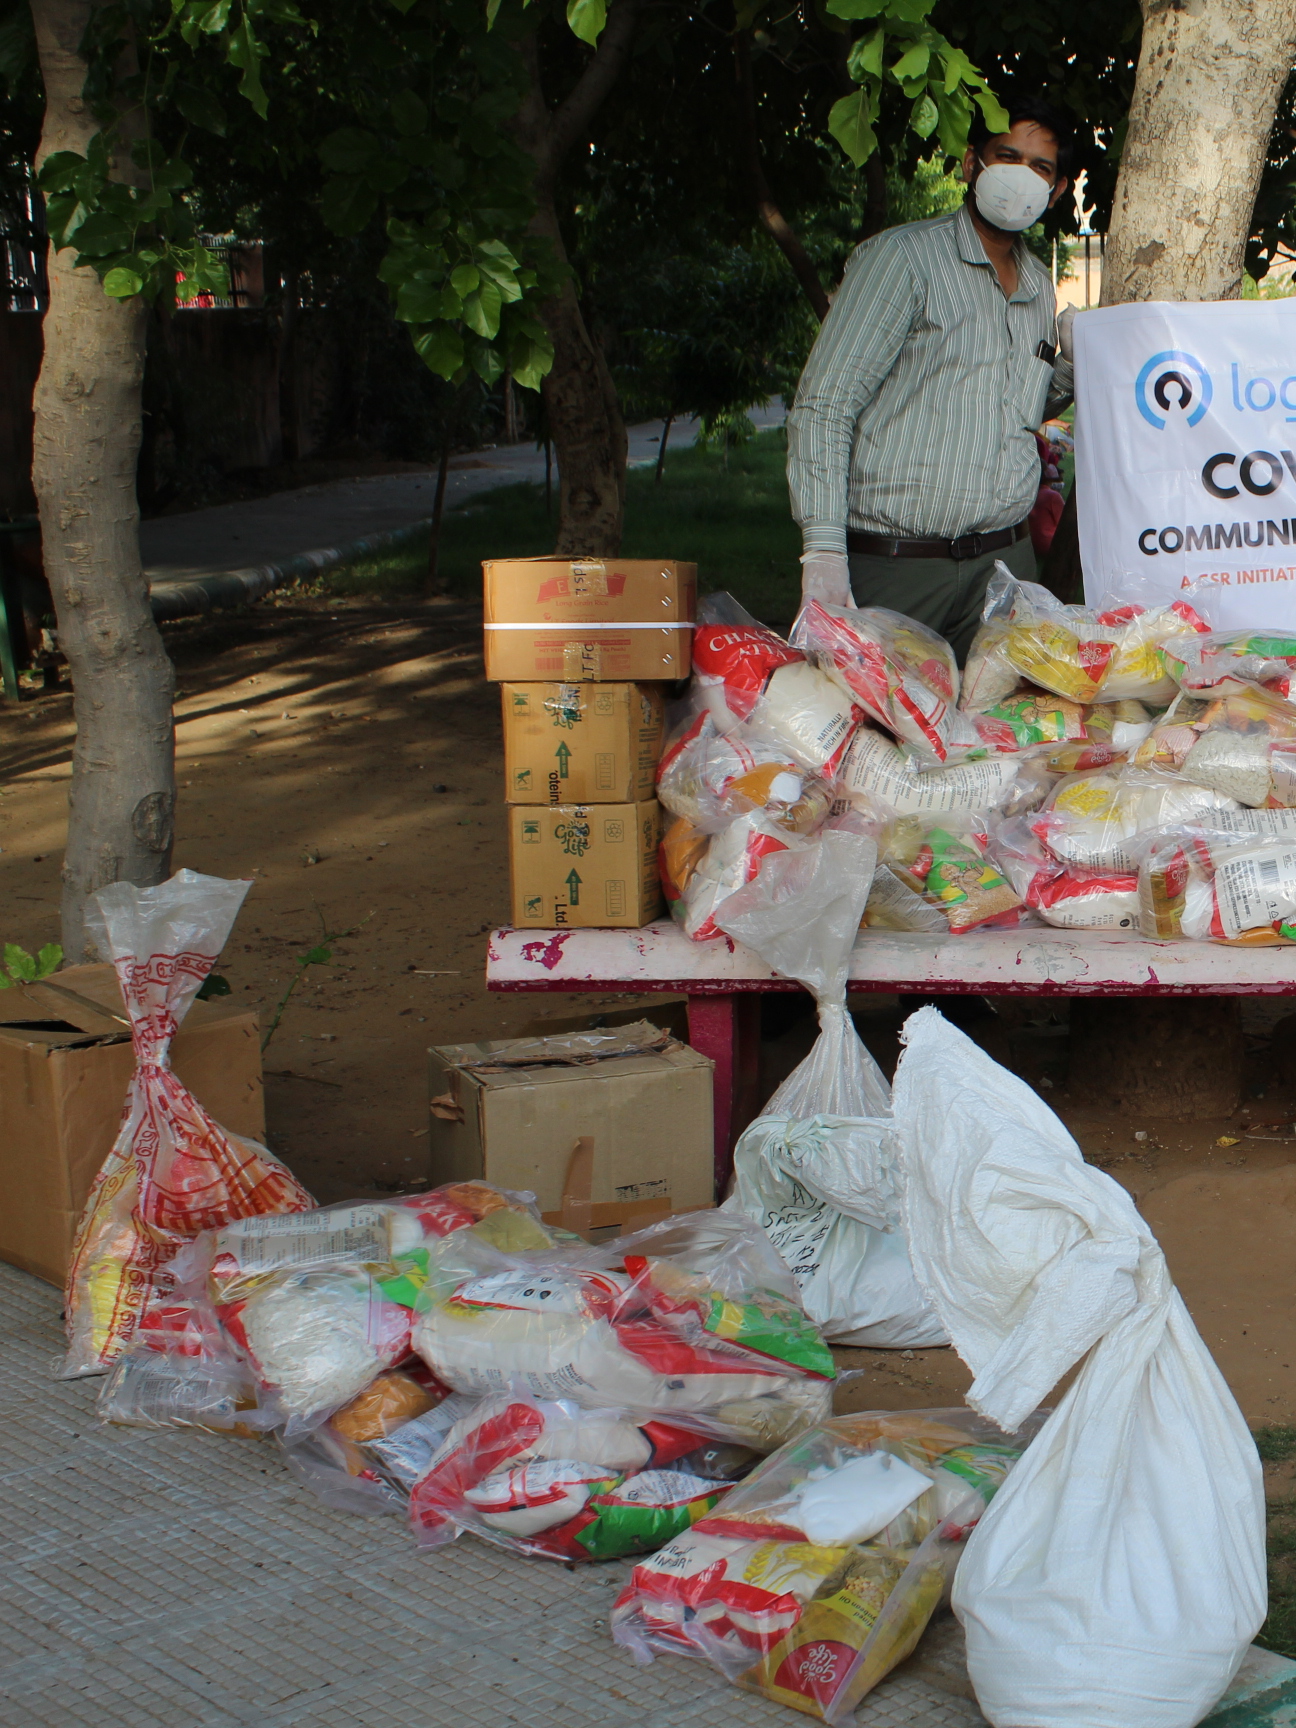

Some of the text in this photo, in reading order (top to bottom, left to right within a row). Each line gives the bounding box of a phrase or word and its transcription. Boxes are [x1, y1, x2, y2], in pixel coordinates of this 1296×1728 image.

[555, 903, 568, 926] Ltd.
[809, 1644, 838, 1666] Life
[799, 1660, 836, 1683] Good
